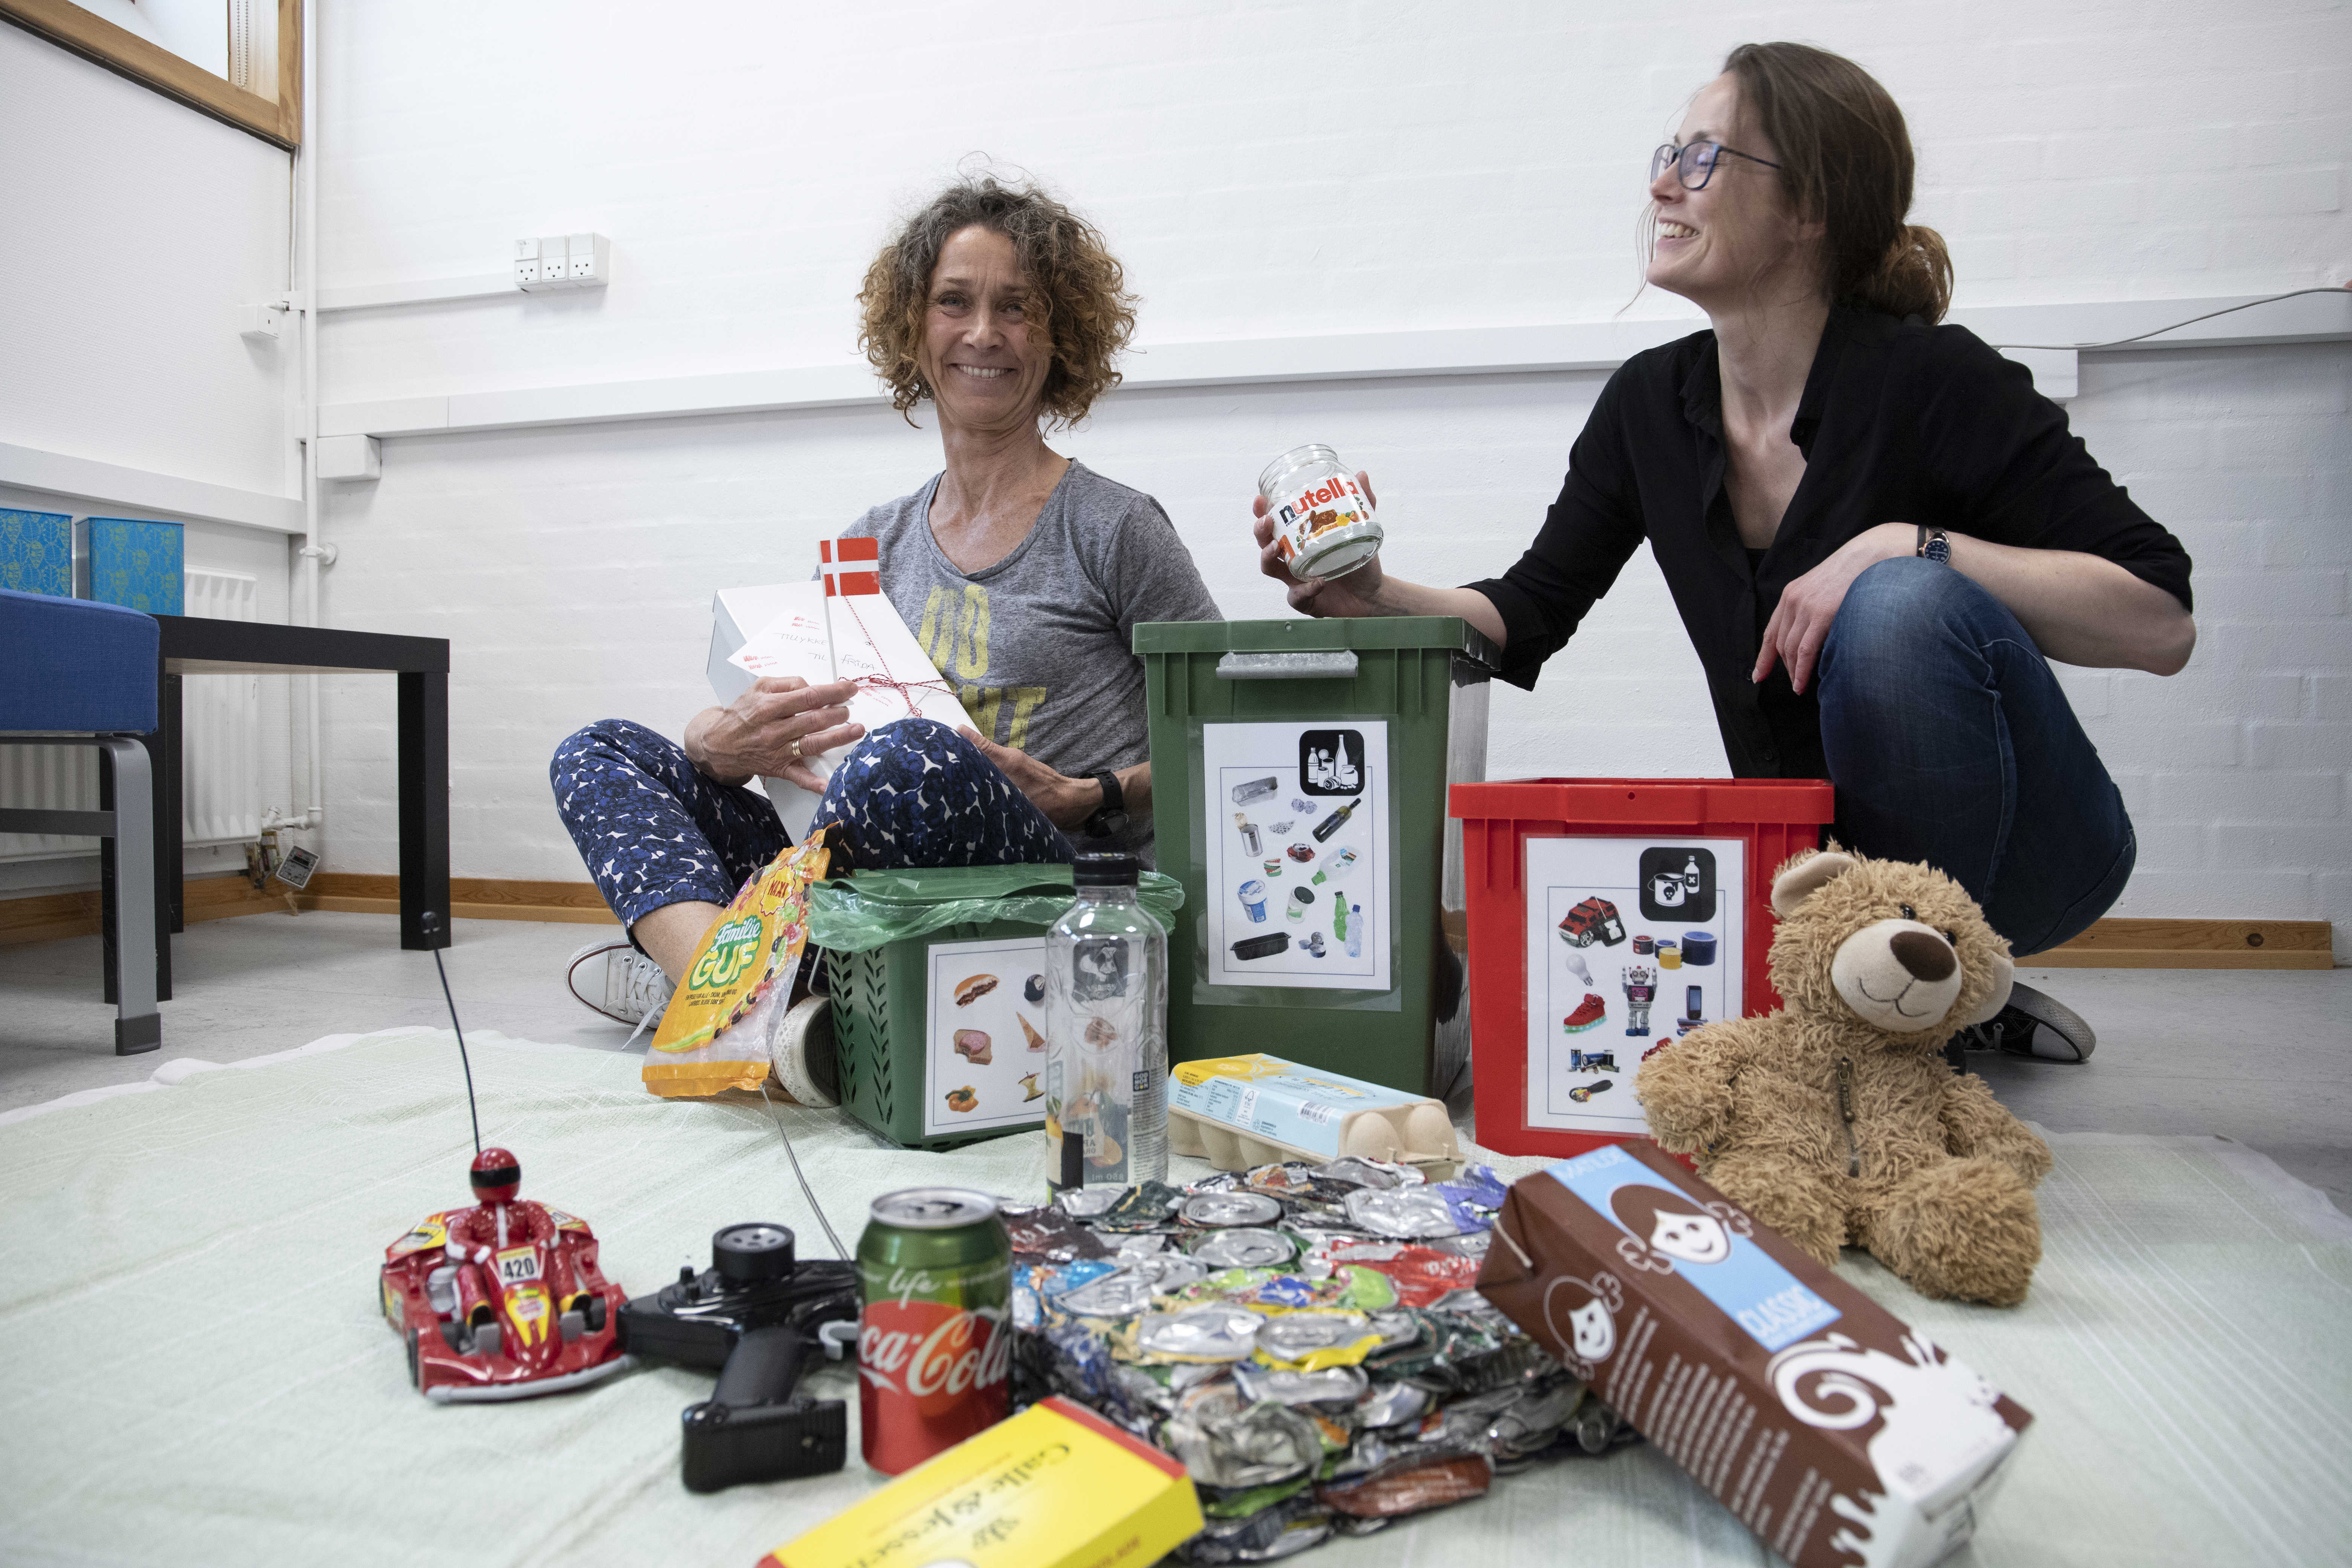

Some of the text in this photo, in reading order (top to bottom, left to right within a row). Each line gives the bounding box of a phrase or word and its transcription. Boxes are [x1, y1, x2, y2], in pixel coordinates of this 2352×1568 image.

[1279, 478, 1359, 524] nutella
[1286, 514, 1303, 527] FERRERO
[767, 879, 790, 899] MAXI
[711, 917, 761, 952] Familie
[692, 940, 759, 986] GUF
[504, 1256, 535, 1279] 420
